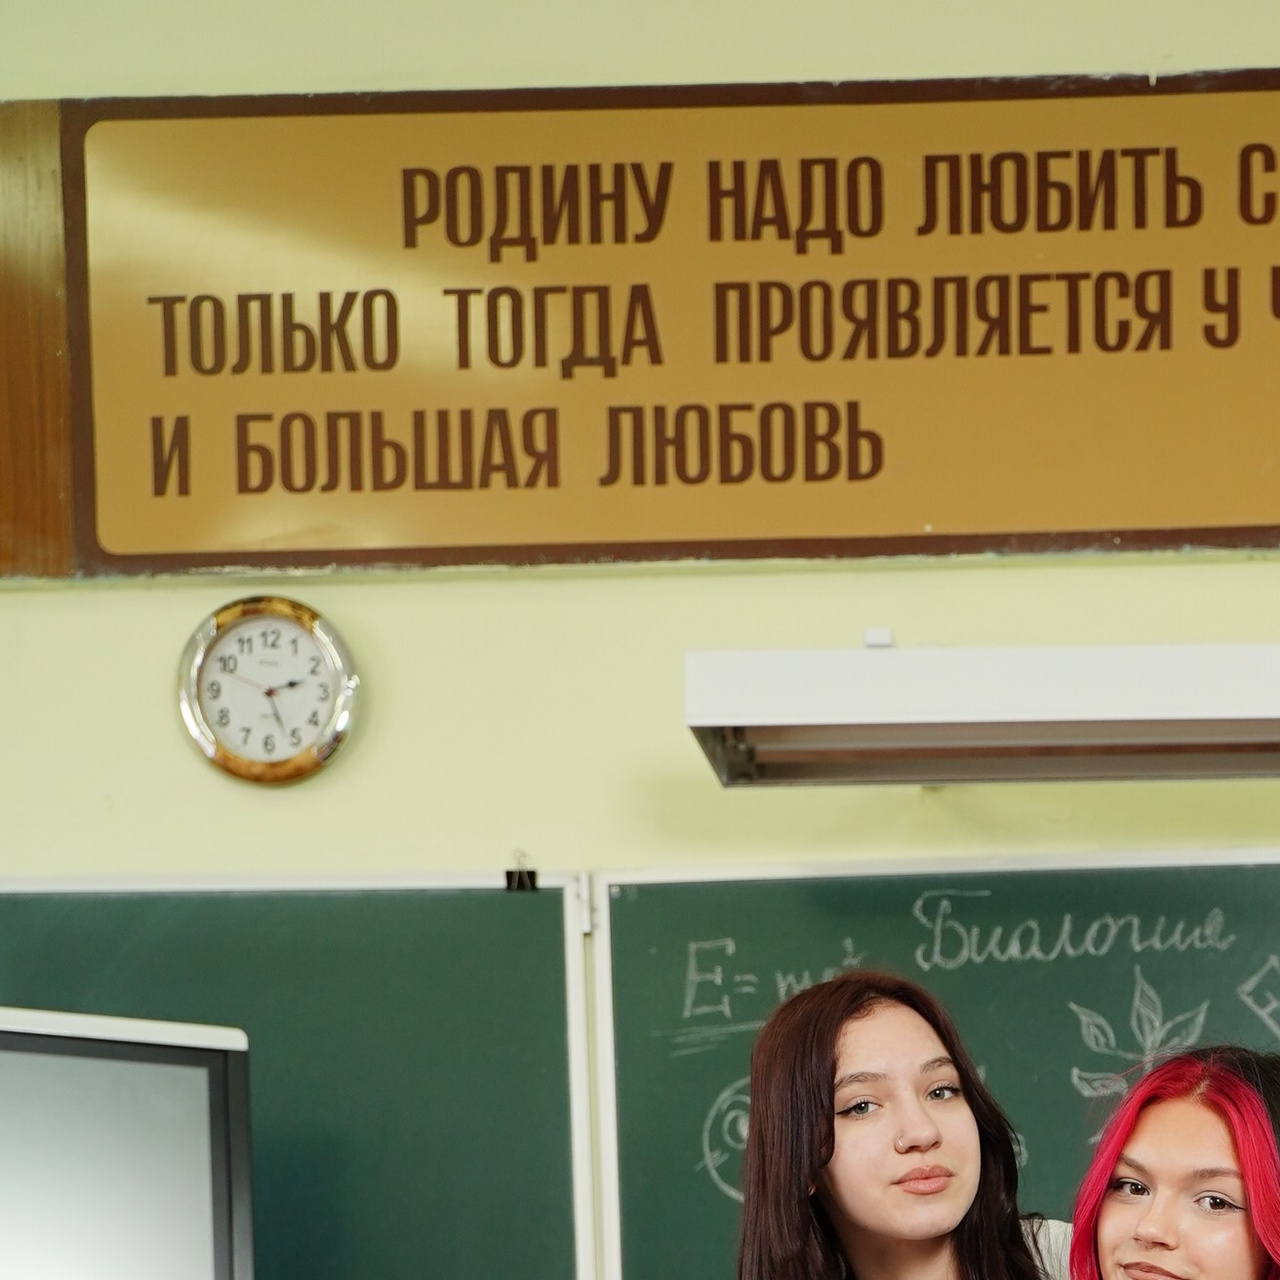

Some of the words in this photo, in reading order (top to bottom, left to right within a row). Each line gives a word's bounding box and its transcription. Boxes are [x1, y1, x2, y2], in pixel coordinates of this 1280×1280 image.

[401, 161, 675, 264] РОДИНУ
[706, 156, 885, 256] НАДО
[915, 146, 1205, 237] ЛЮБИТЬ
[1237, 142, 1279, 227] С
[146, 287, 401, 378] ТОЛЬКО
[441, 282, 665, 381] ТОГДА
[712, 268, 1174, 365] ПРОЯВЛЯЕТСЯ
[1201, 266, 1241, 350] У
[150, 415, 191, 498] И
[234, 407, 561, 497] БОЛЬШАЯ
[598, 399, 885, 490] ЛЮБОВЬ
[237, 635, 253, 654] 11
[260, 629, 281, 648] 12
[290, 638, 299, 654] 1
[218, 655, 238, 673] 10
[309, 656, 322, 675] 2
[207, 680, 222, 701] 9
[319, 682, 330, 701] 3
[216, 707, 230, 727] 8
[308, 709, 319, 727] 4
[240, 727, 252, 745] 7
[263, 733, 275, 753] 6
[289, 728, 302, 746] 5
